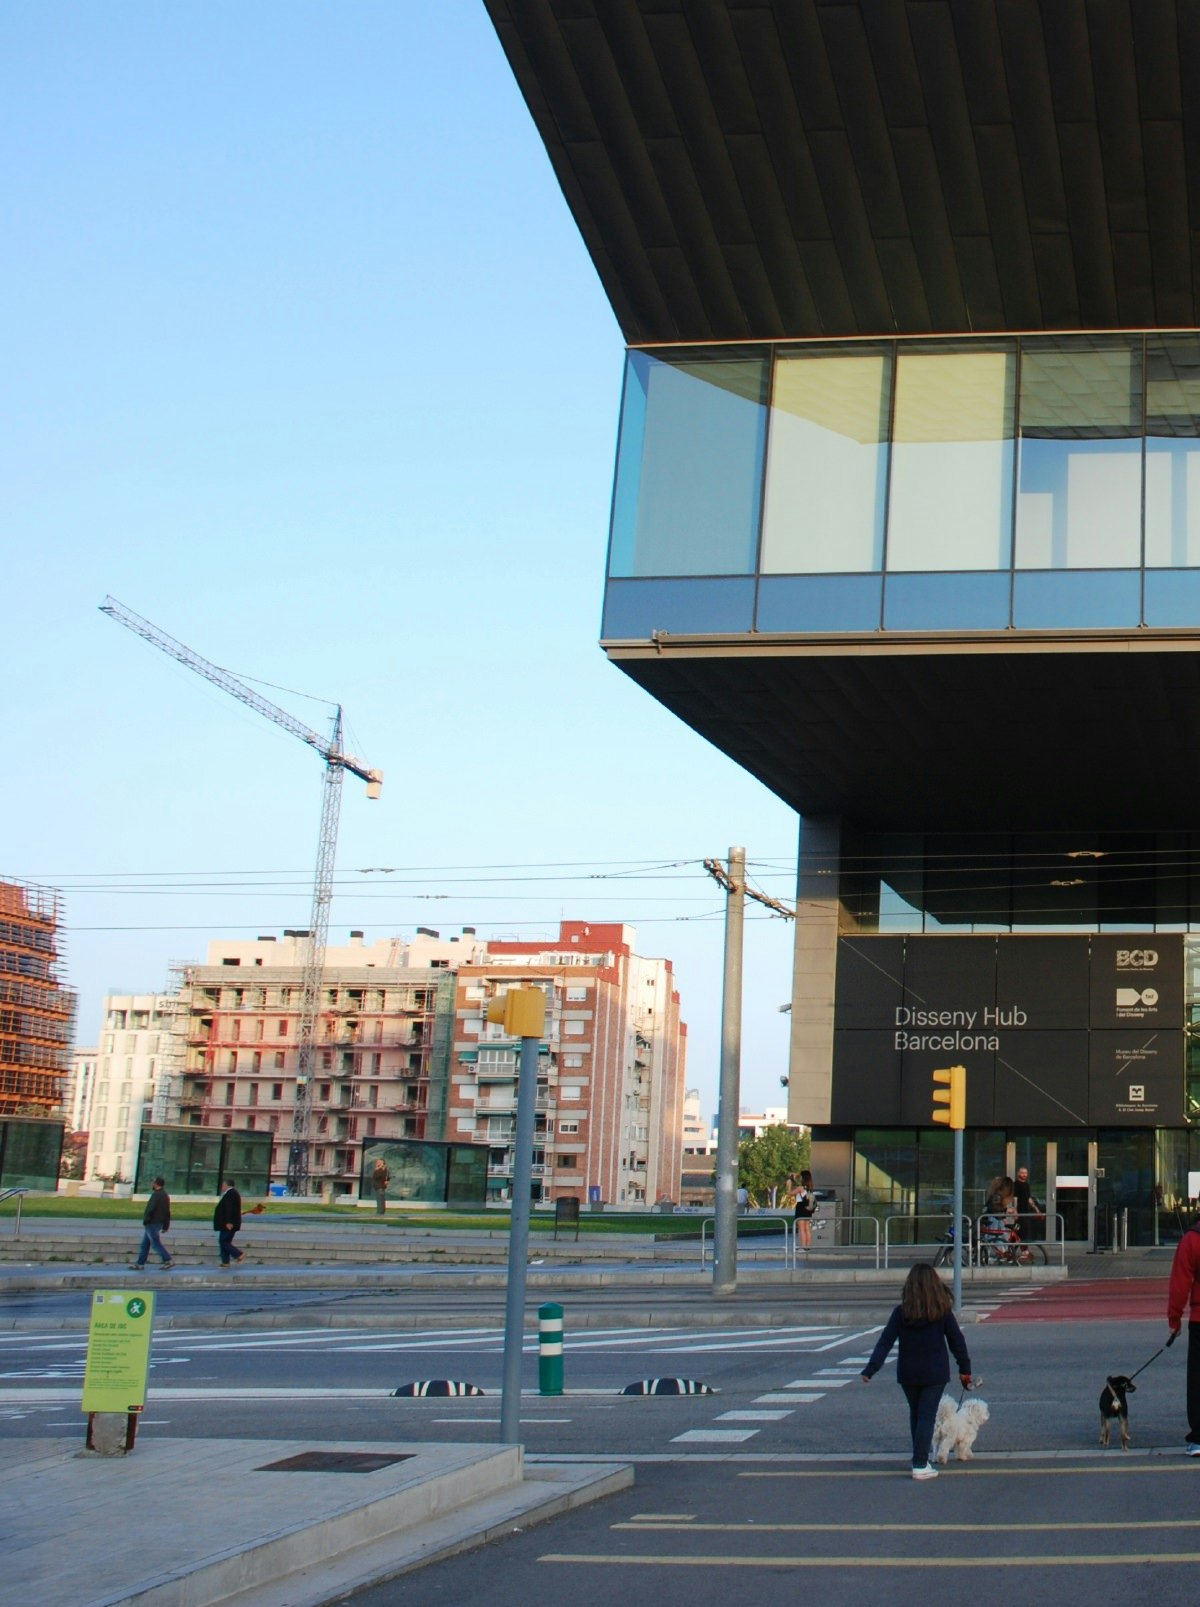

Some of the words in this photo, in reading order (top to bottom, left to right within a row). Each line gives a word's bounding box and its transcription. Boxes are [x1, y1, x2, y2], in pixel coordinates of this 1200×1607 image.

[1116, 949, 1159, 967] BCD
[895, 1006, 977, 1029] Disseny
[984, 1005, 1027, 1026] Hub
[894, 1030, 999, 1050] Barcelona
